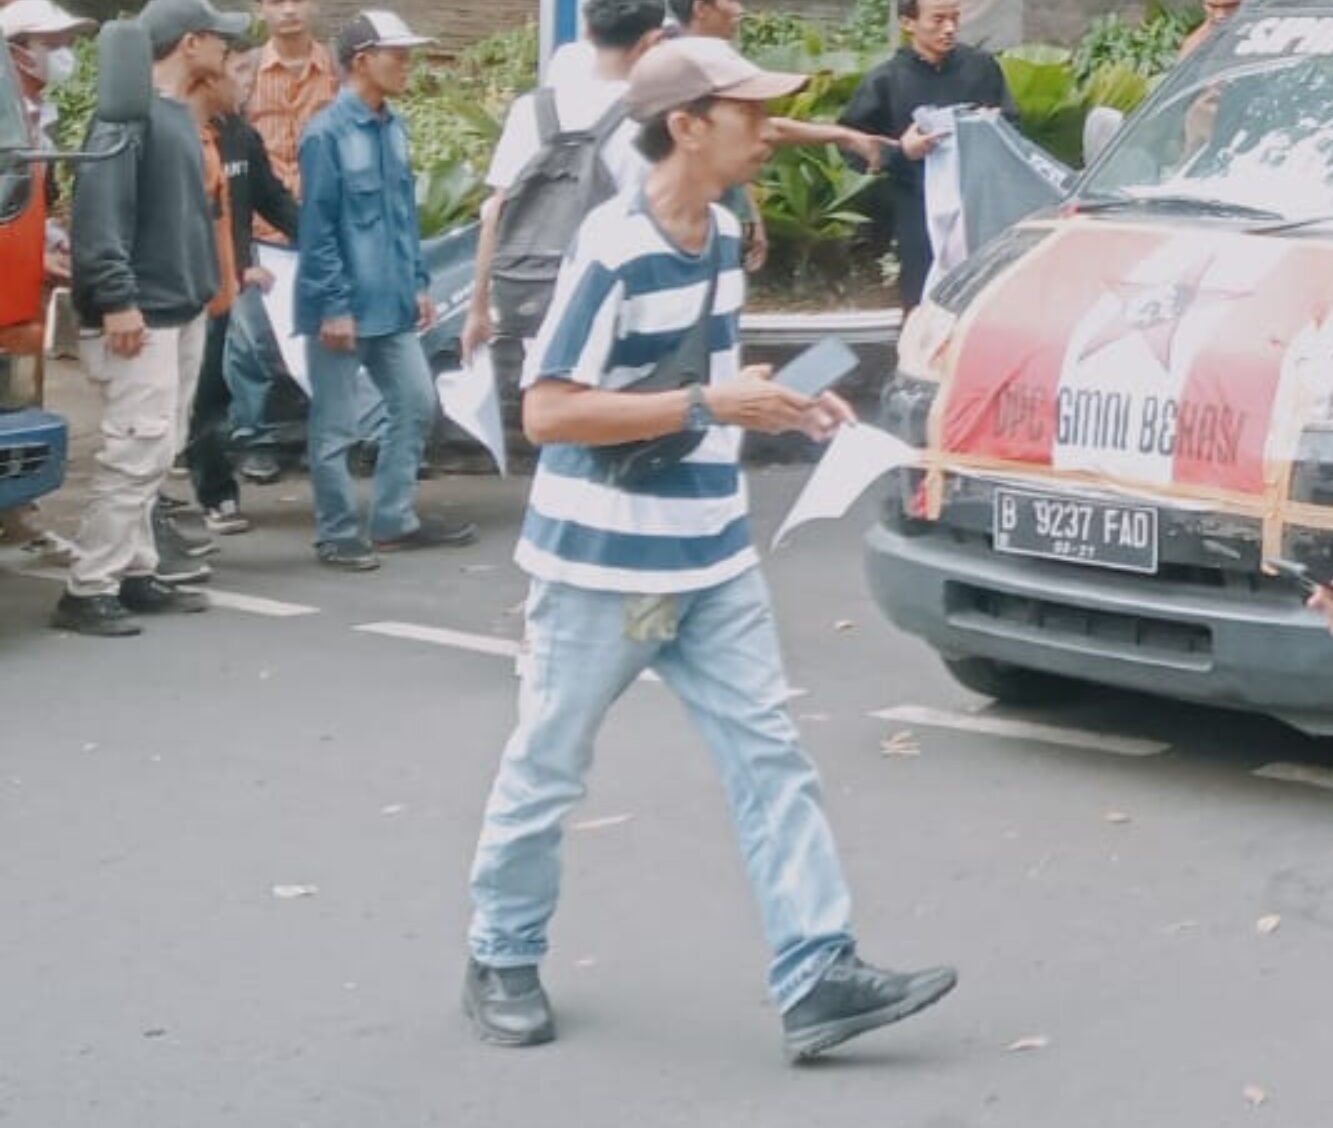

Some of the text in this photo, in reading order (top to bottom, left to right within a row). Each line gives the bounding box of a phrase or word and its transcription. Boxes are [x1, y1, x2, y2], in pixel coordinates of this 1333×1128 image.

[992, 383, 1048, 442] DPC
[1138, 395, 1249, 464] BEKASI
[1001, 495, 1017, 530] B
[1033, 499, 1094, 541] 9237
